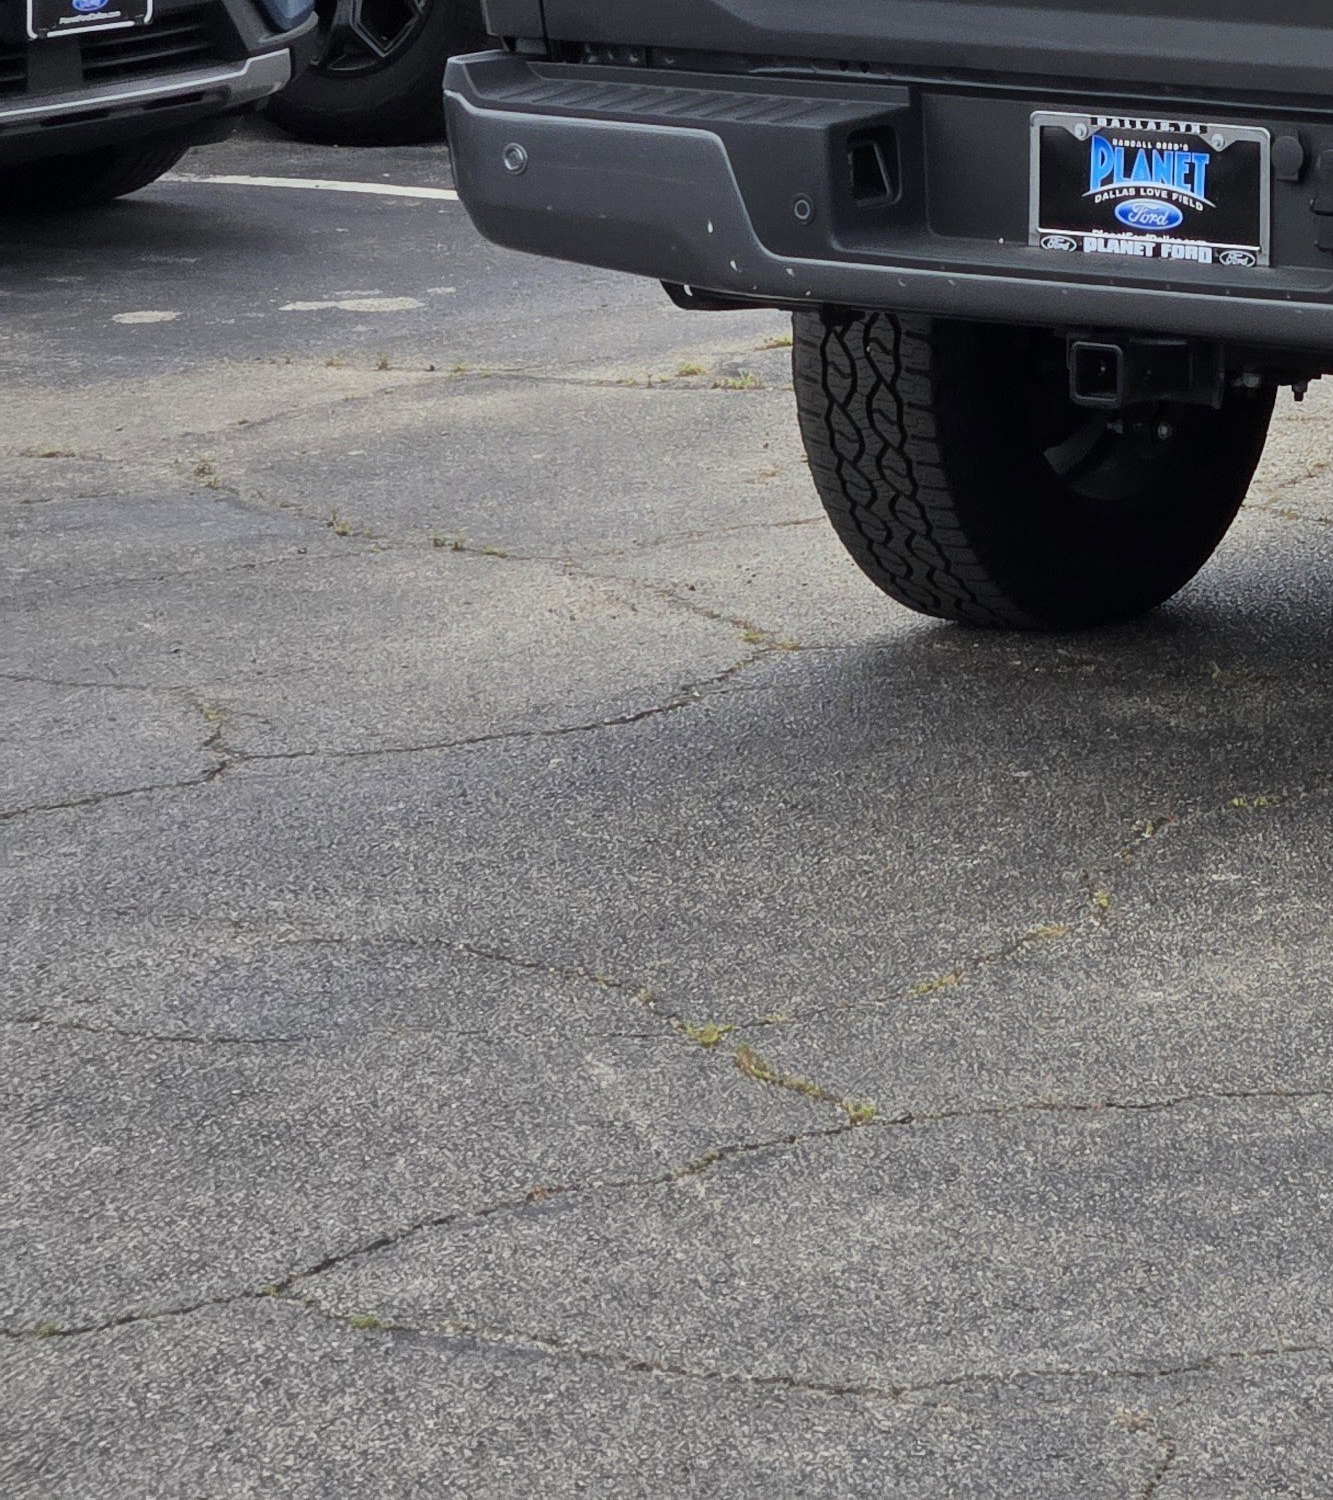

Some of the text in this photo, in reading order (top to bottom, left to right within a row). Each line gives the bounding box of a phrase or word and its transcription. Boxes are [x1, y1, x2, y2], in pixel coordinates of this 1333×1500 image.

[1091, 135, 1210, 199] PLANET
[1094, 187, 1204, 211] DALLAS LOVE FIELD
[1128, 203, 1169, 226] Ford
[1083, 236, 1156, 258] PLANET
[1160, 243, 1213, 264] FORD
